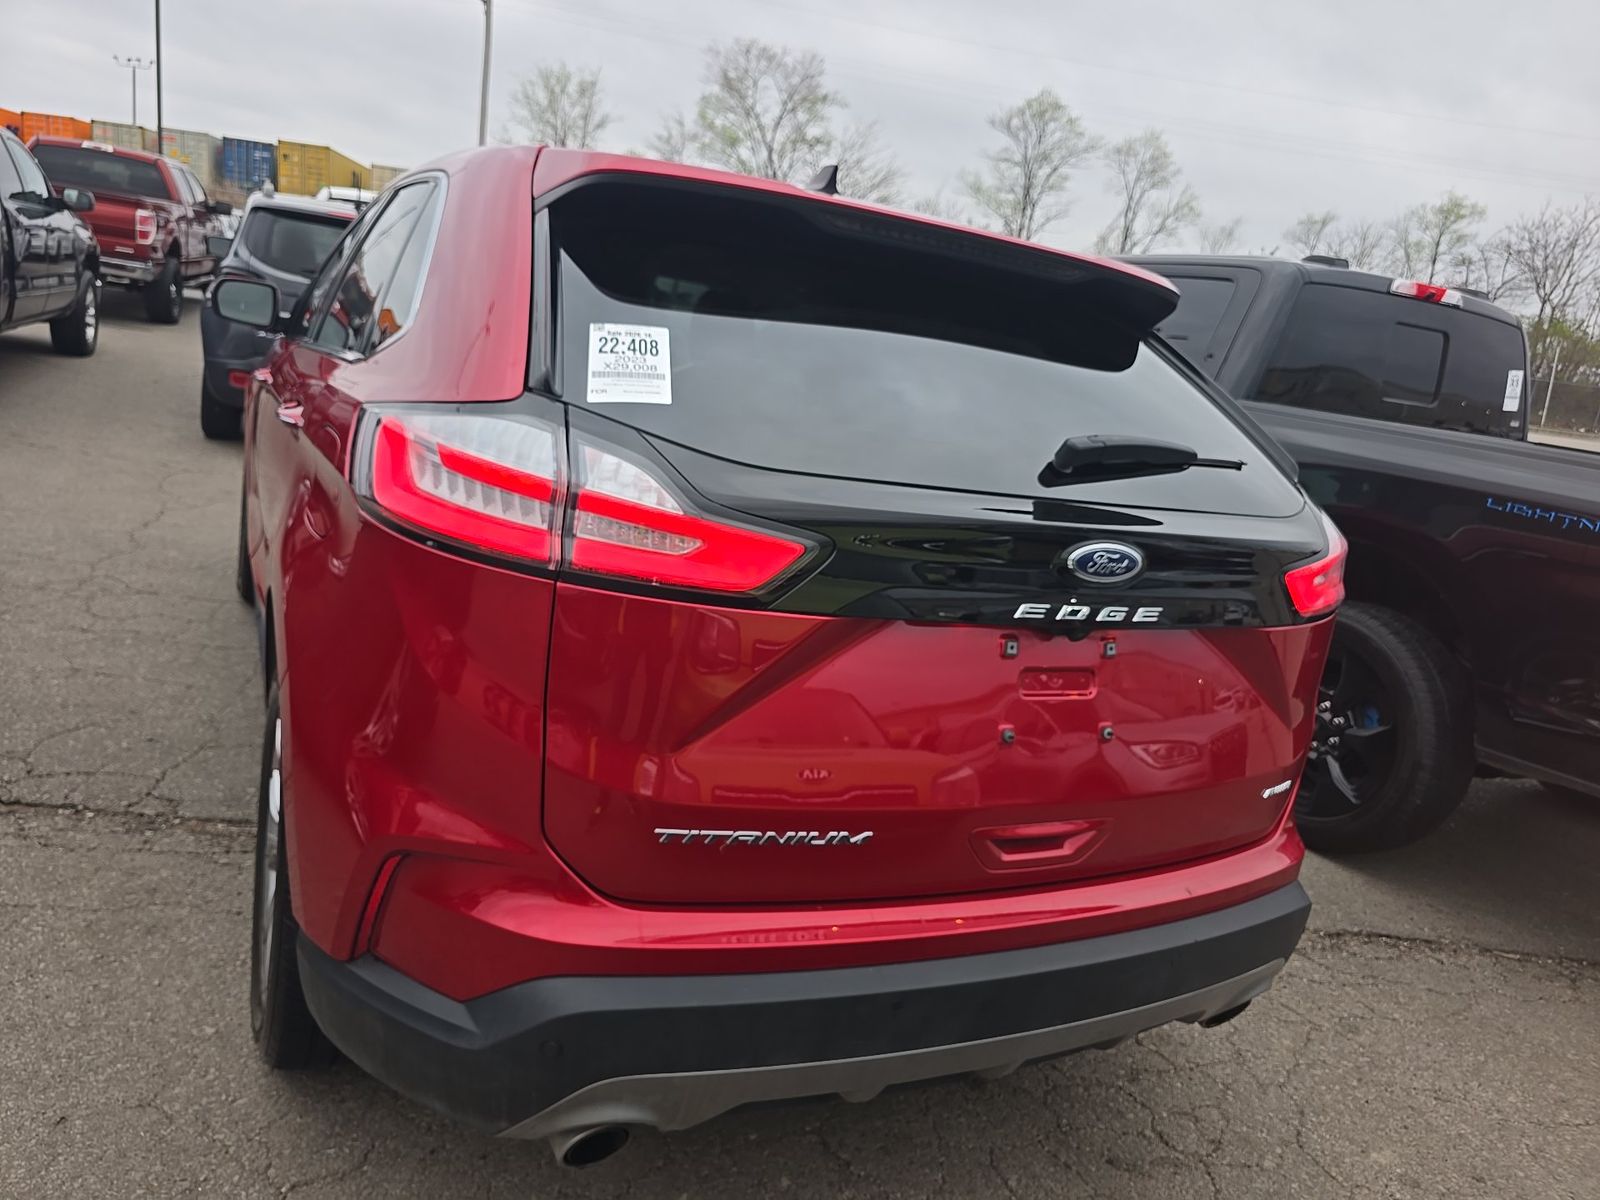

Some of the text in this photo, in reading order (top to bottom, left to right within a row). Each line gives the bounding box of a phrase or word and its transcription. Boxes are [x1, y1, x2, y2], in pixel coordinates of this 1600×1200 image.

[598, 336, 659, 357] 22:408
[614, 356, 647, 364] 2023
[1086, 551, 1129, 574] Ford
[1013, 603, 1164, 622] EDGE
[654, 828, 873, 846] TITANIUM
